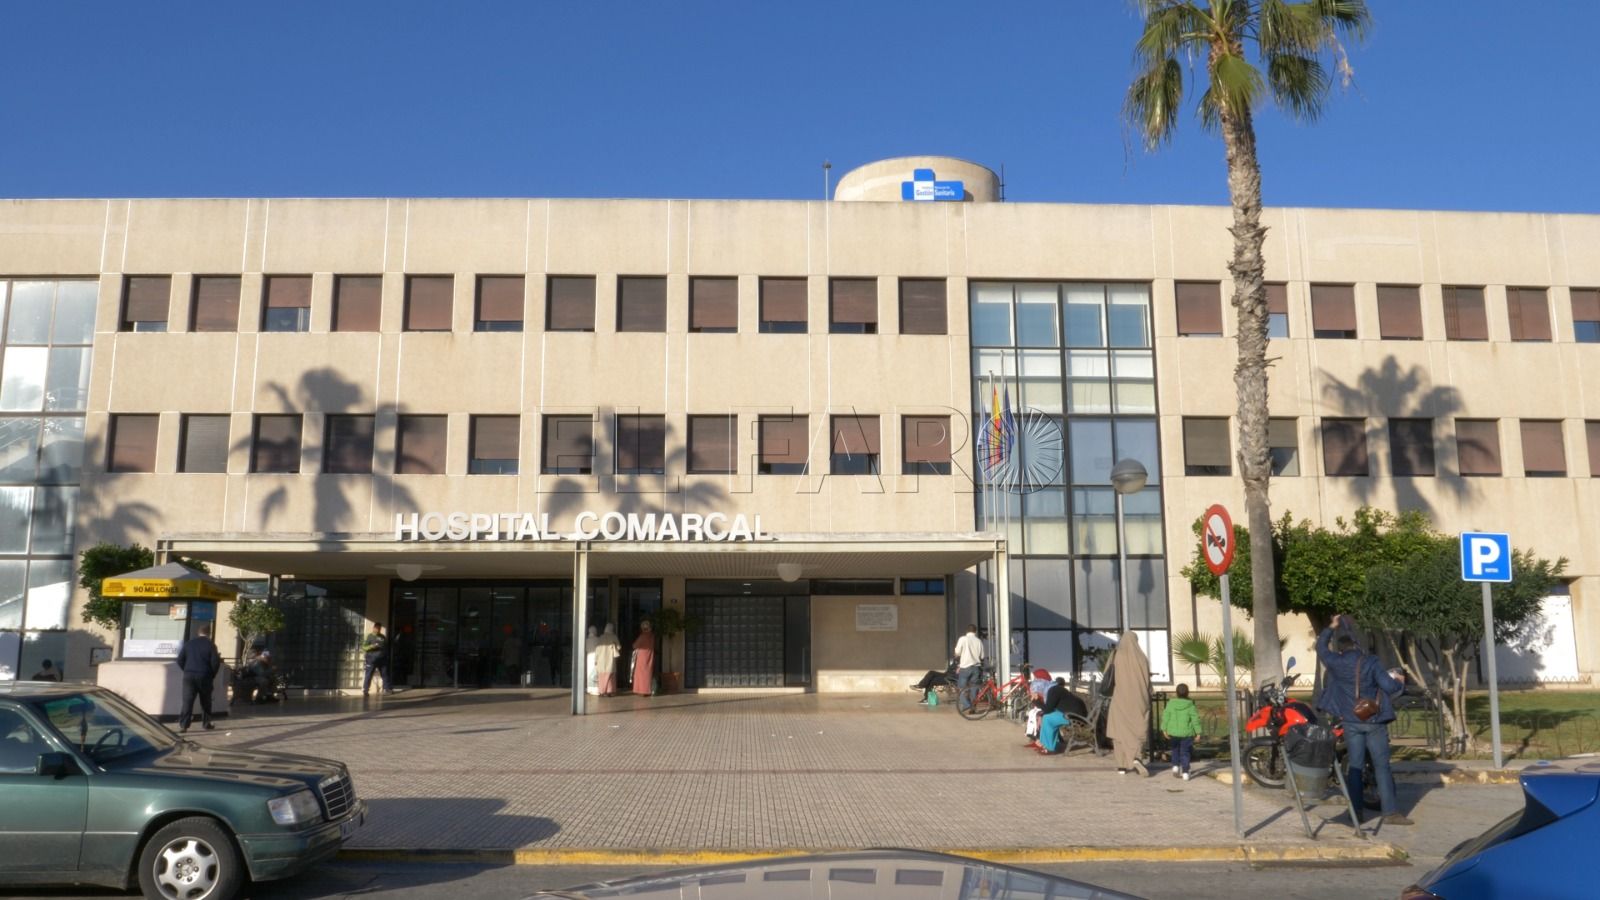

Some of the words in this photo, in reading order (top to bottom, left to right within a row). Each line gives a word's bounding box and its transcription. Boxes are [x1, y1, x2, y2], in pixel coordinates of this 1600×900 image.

[395, 511, 560, 541] HOSPITAL
[574, 511, 772, 541] COMARCAL
[1471, 537, 1500, 576] P
